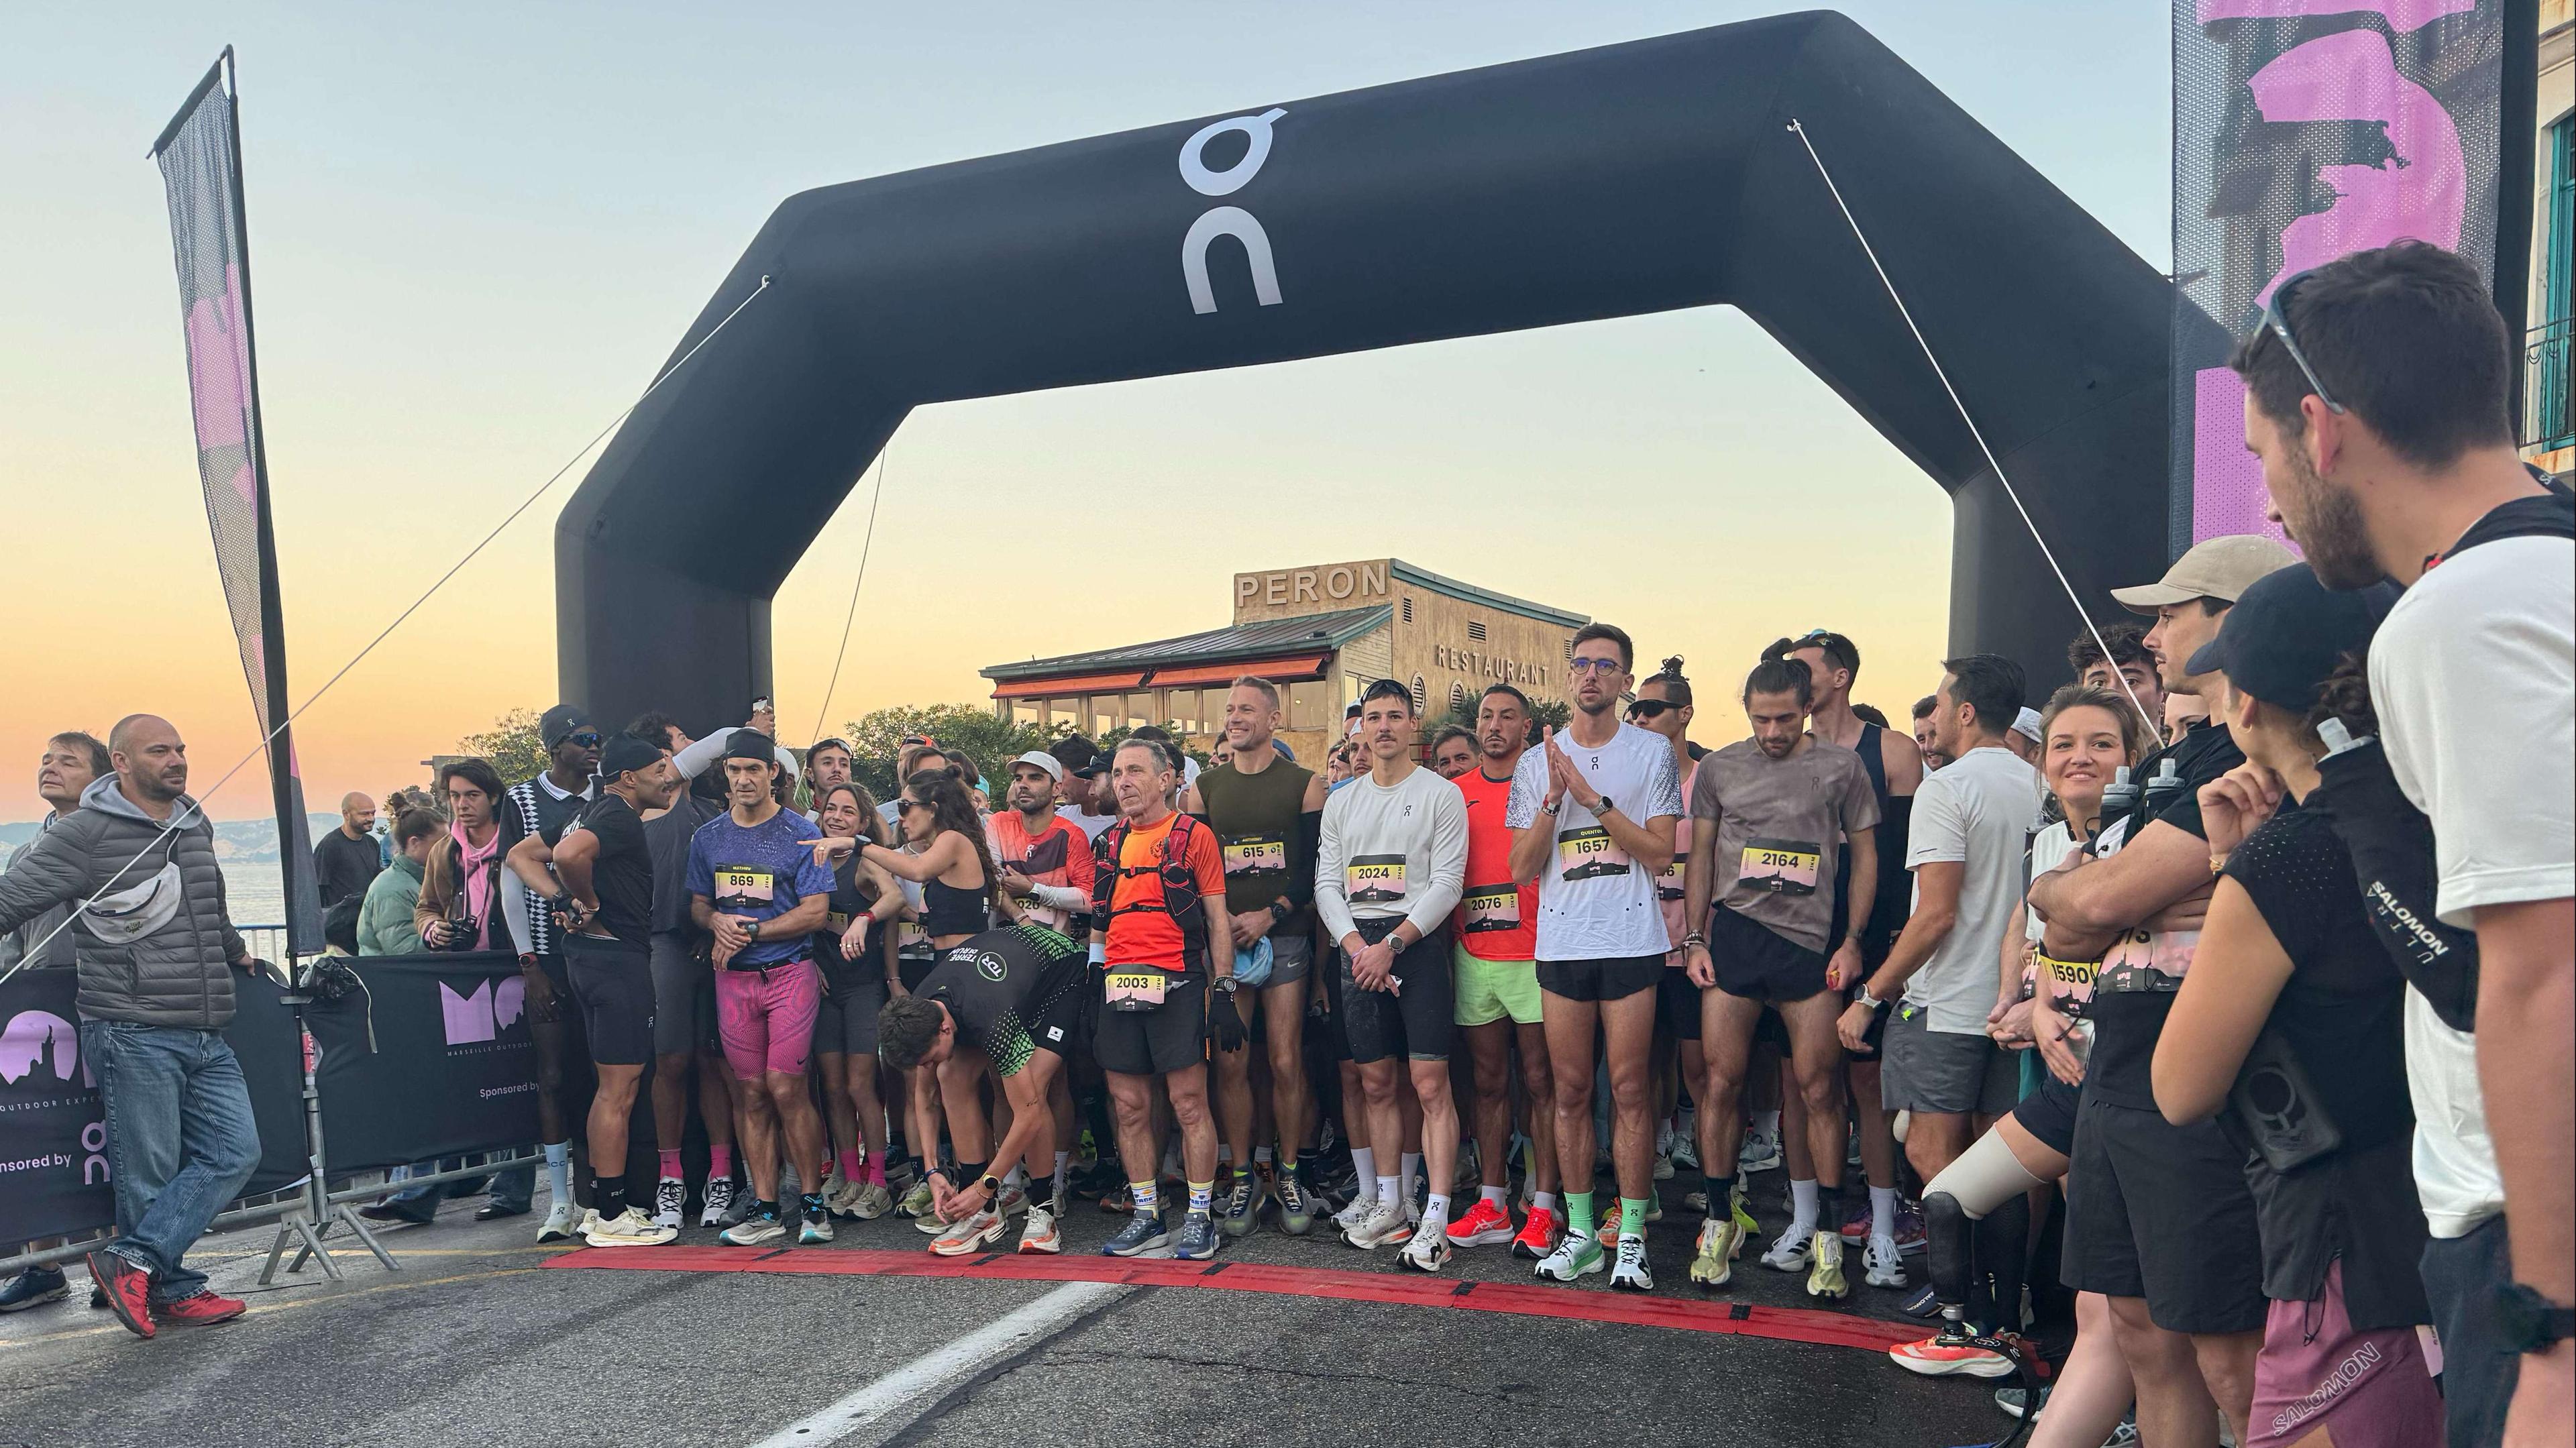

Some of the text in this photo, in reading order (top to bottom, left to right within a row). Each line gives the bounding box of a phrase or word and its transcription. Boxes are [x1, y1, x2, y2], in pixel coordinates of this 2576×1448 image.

[1237, 563, 1386, 608] PERON
[1438, 643, 1550, 685] RESTAURANT
[1243, 846, 1264, 858] 615
[1575, 839, 1610, 854] 1657
[1761, 852, 1799, 869] 2164
[1358, 867, 1390, 879] 2024
[730, 875, 754, 887] 869
[1014, 900, 1039, 910] 020
[1471, 897, 1501, 911] 2076
[2371, 881, 2449, 956] SALOMON
[949, 954, 977, 962] TERRE
[981, 955, 1002, 977] TDR
[2051, 963, 2089, 985] 1590
[1116, 977, 1148, 989] 2003
[480, 1082, 528, 1100] Sponsored
[0, 1100, 58, 1112] OUTDOOR
[54, 1153, 72, 1168] by
[2272, 1341, 2381, 1437] SALOMON
